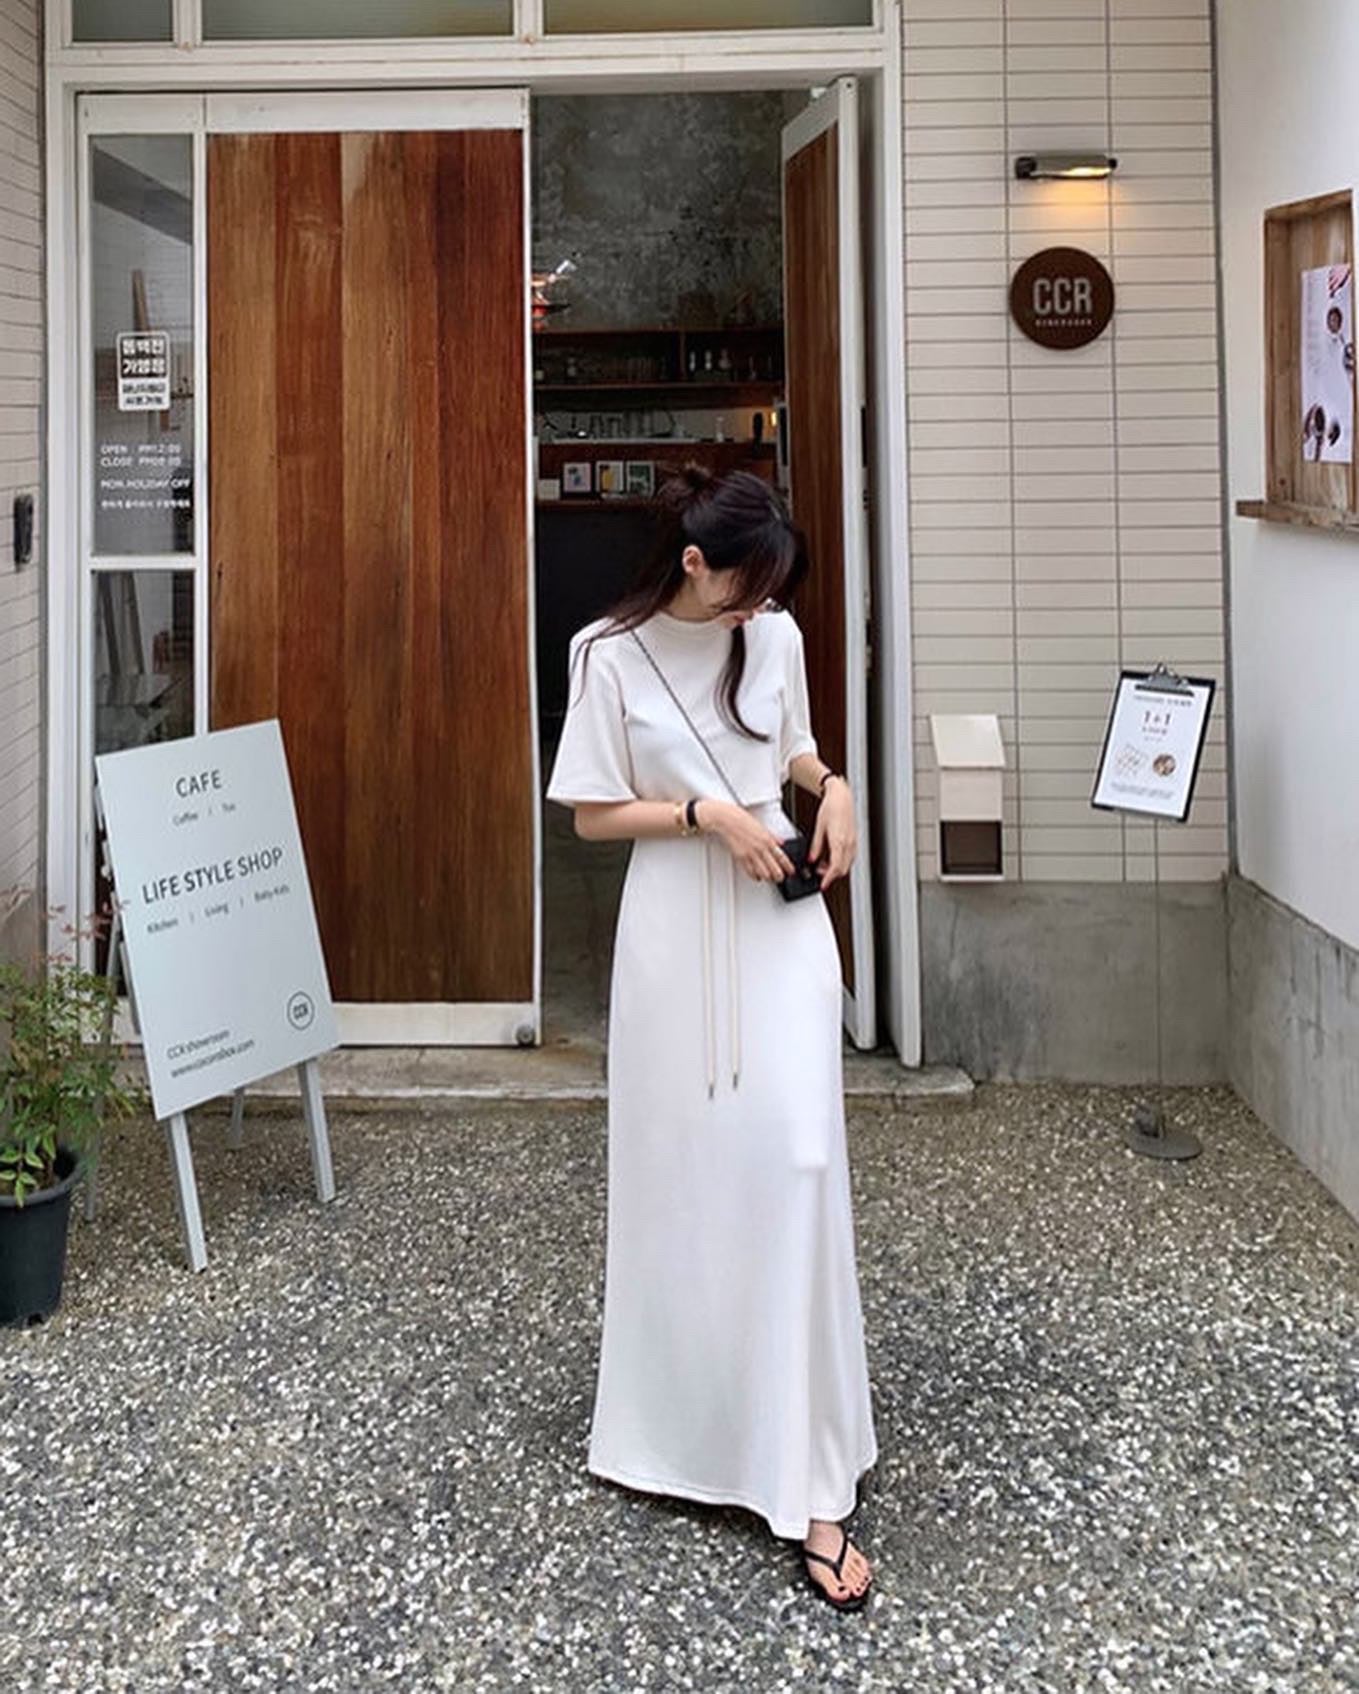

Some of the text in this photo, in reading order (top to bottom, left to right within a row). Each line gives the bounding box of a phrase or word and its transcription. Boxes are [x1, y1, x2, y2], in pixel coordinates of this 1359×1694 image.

[1033, 277, 1092, 315] CCR
[101, 444, 127, 454] OPEN
[101, 456, 132, 467] CLOSE
[175, 769, 222, 798] CAFE
[142, 847, 283, 905] LIFE STYLE SHOP
